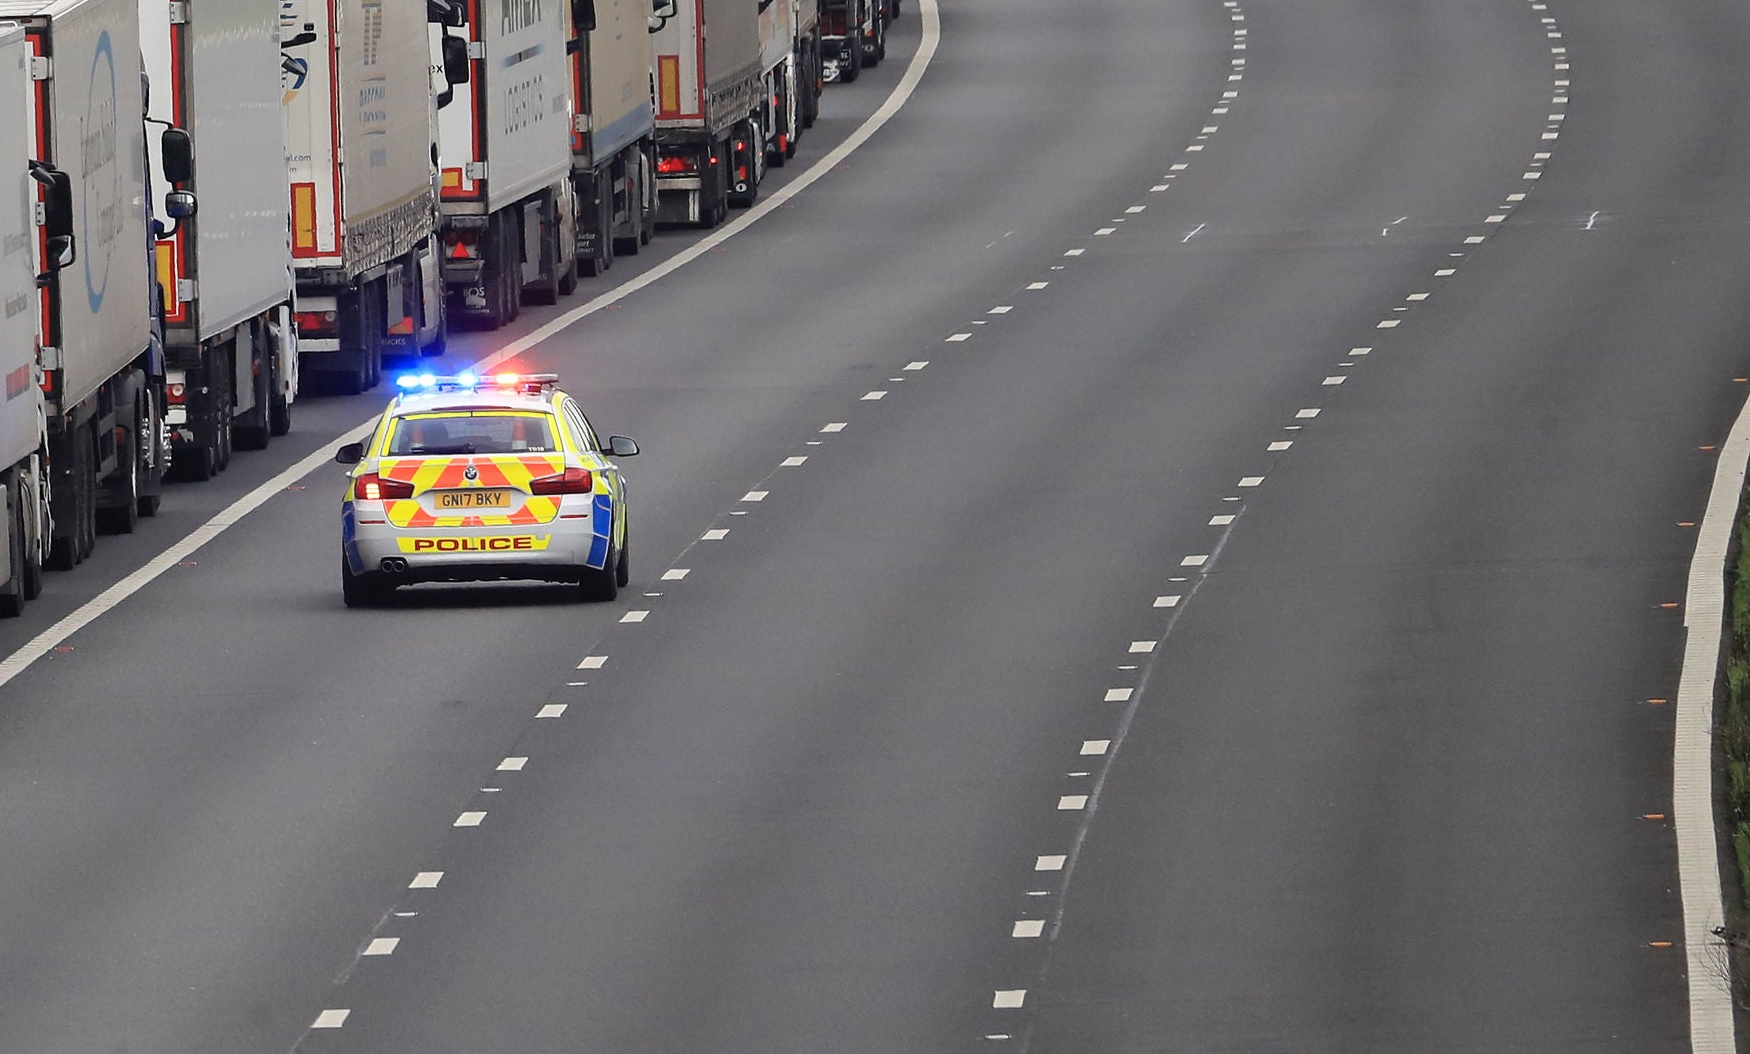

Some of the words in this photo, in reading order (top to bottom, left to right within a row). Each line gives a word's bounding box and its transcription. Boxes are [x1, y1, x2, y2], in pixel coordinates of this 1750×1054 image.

[442, 493, 472, 507] GN17
[476, 492, 502, 506] BKY
[414, 536, 533, 552] POLICE
